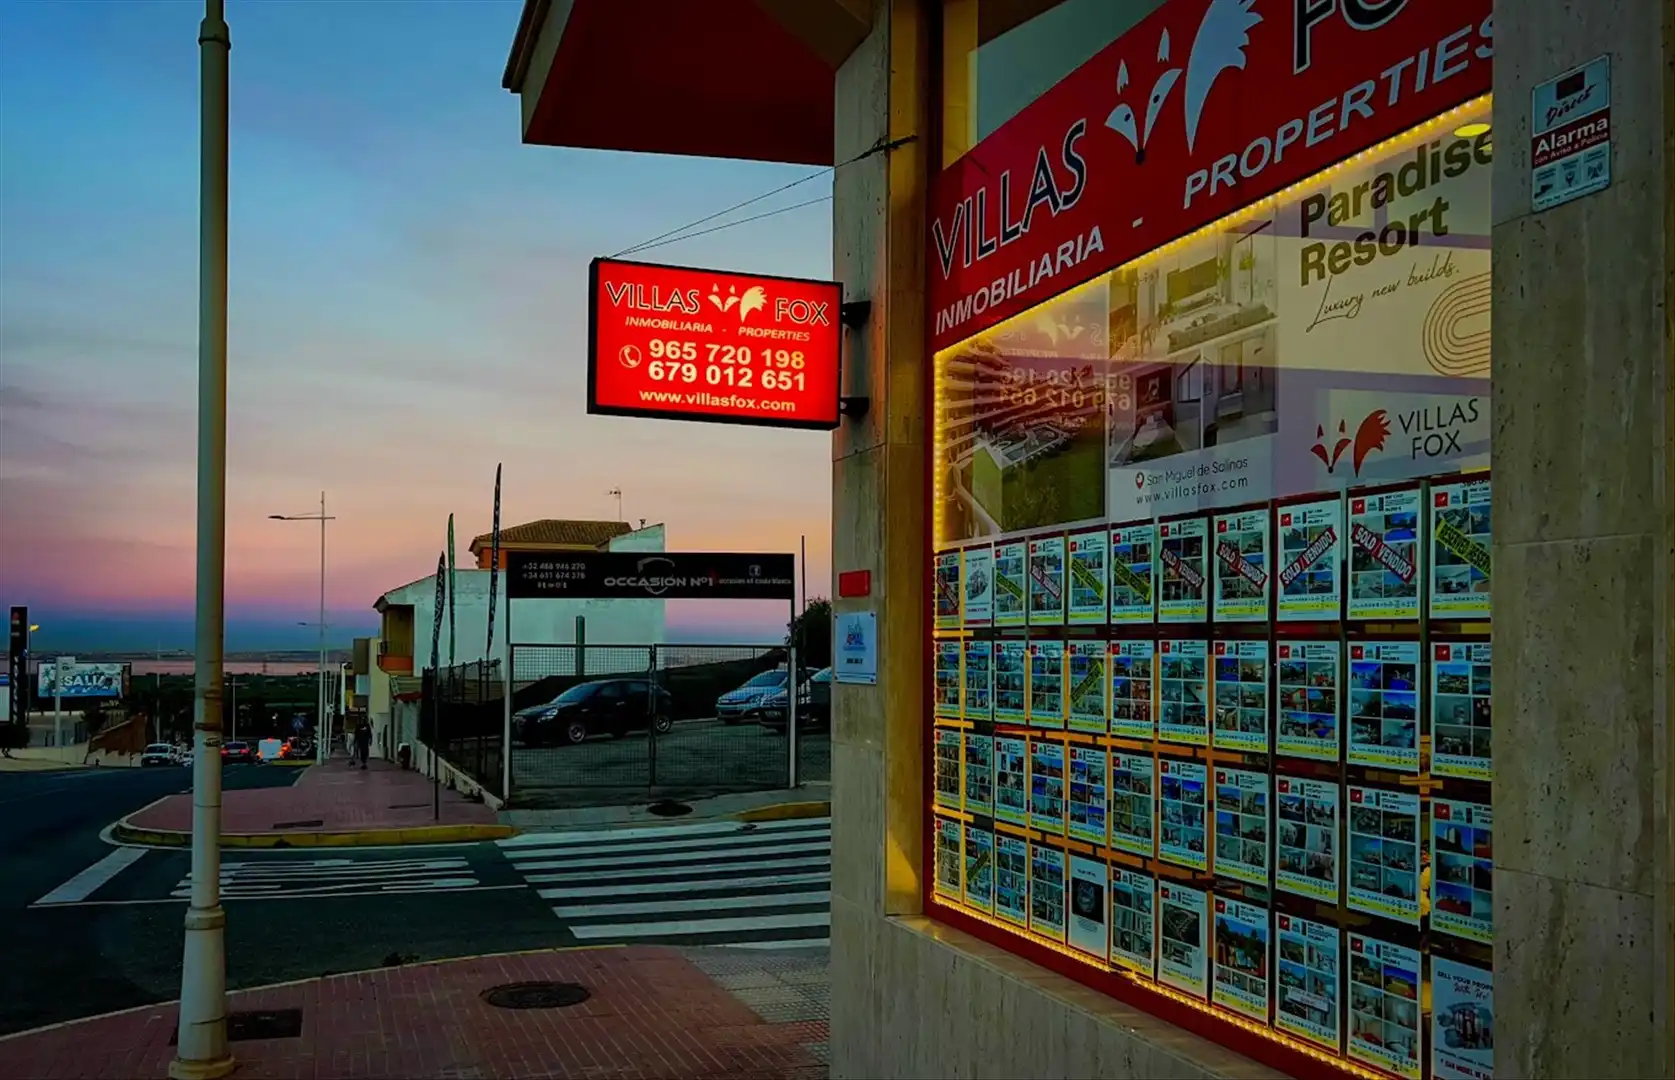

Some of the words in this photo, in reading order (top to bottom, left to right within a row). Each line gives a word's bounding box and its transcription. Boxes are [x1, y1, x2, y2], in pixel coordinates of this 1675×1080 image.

[1535, 117, 1609, 156] Alarma
[931, 117, 1088, 281] VILLAS
[1300, 130, 1492, 239] Paradise
[1300, 196, 1449, 287] Resort
[935, 225, 1105, 336] INMOBILIARIA
[604, 281, 700, 314] VILLAS
[775, 297, 830, 327] FOX
[1305, 274, 1364, 333] Luxury
[1371, 279, 1401, 298] new
[625, 316, 713, 333] INMOBILIARIA
[738, 326, 811, 342] PROPERTIES
[649, 338, 697, 361] 965
[705, 343, 752, 365] 720
[761, 348, 806, 369] 198
[648, 360, 697, 383] 679
[706, 365, 753, 388] 012
[761, 369, 806, 392] 651
[639, 390, 796, 412] www.villasfox.com
[1398, 398, 1479, 433] VILLAS
[1412, 429, 1463, 460] FOX
[1147, 474, 1163, 486] San
[1165, 466, 1196, 483] Miguel
[1197, 464, 1210, 477] de
[1212, 458, 1249, 474] Salinas
[1136, 476, 1249, 504] www.villasfox.com
[1302, 530, 1334, 564] VENDIDO
[1378, 542, 1413, 580] VENDIDO
